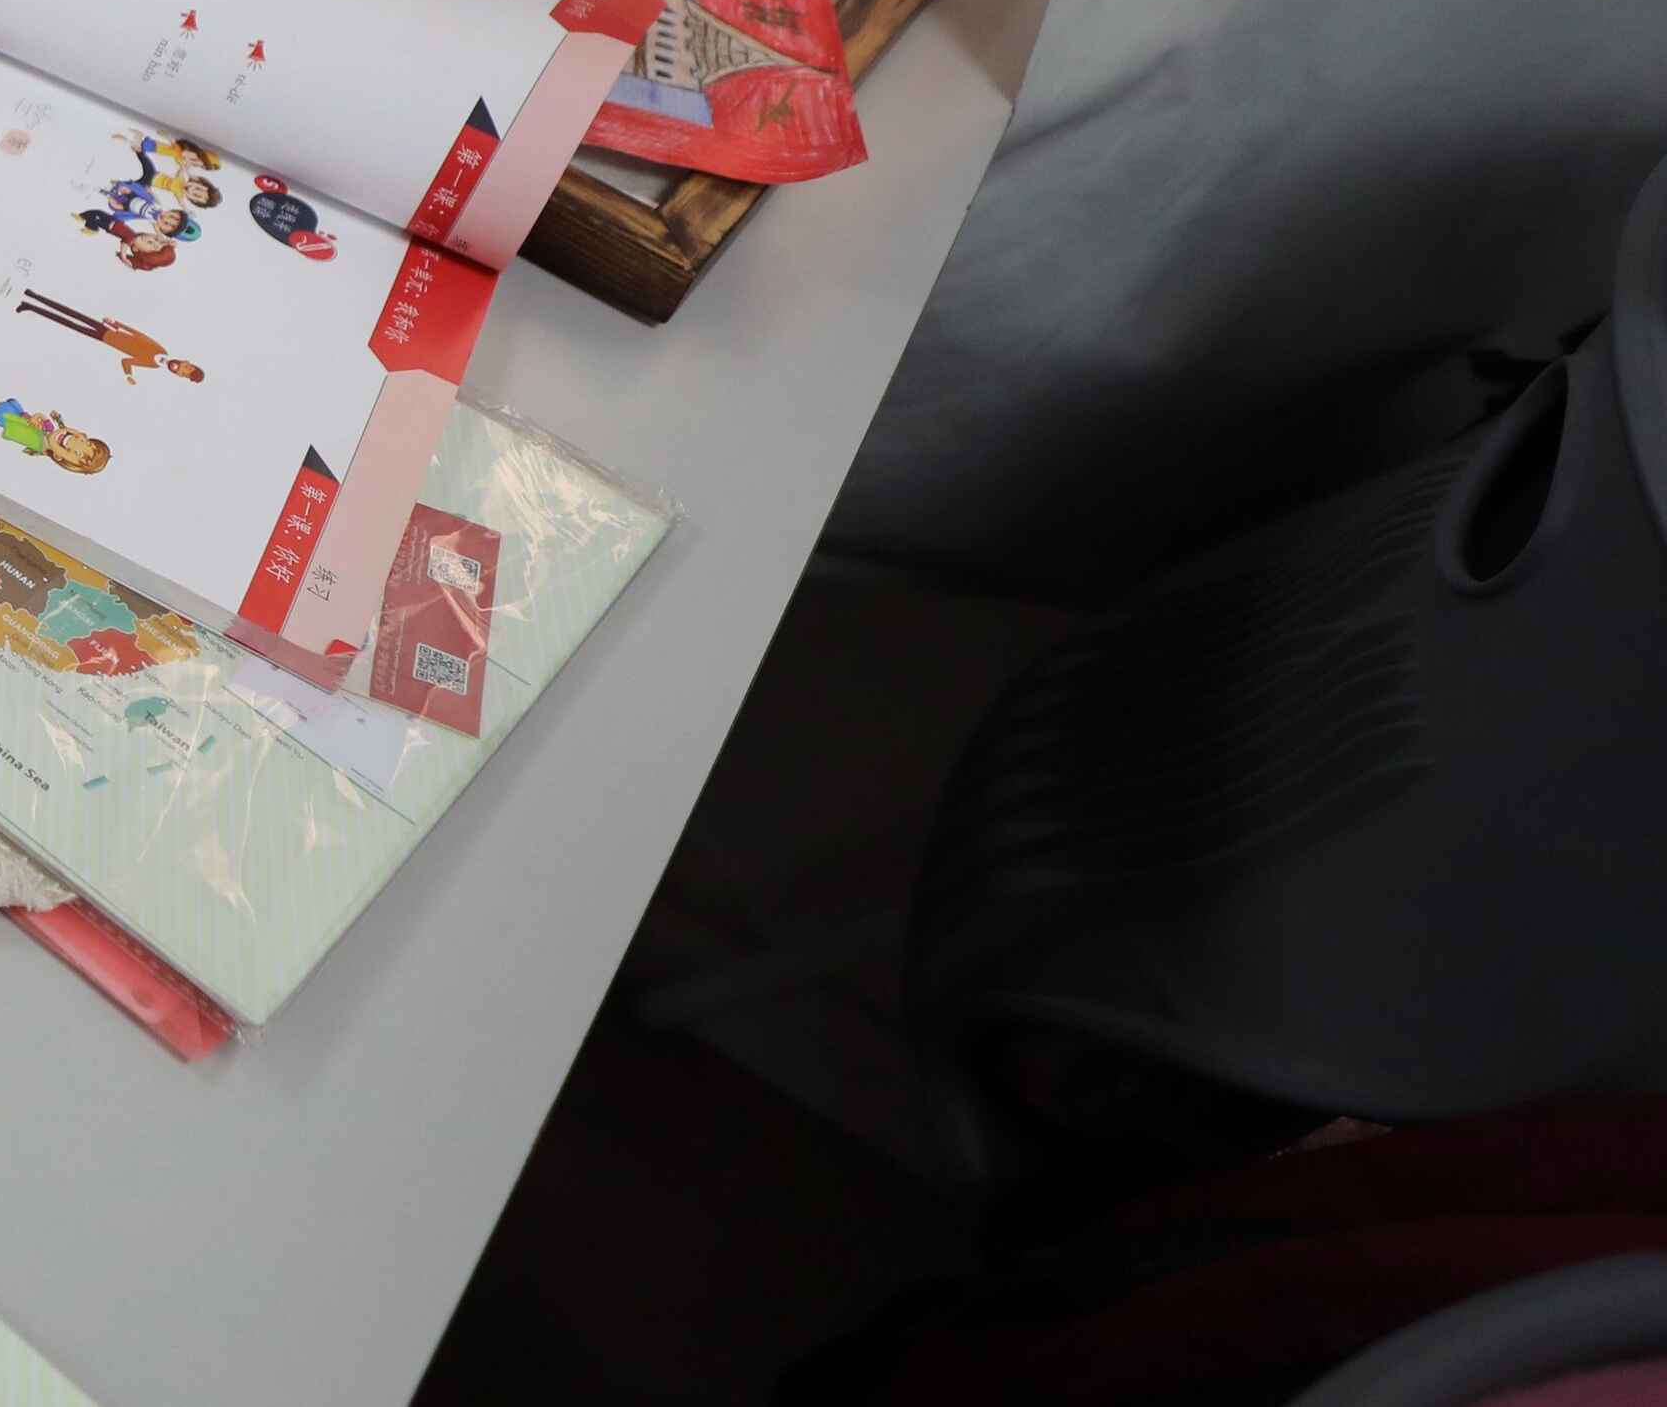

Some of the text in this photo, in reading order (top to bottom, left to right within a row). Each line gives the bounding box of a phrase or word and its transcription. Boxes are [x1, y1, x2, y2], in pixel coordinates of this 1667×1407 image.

[264, 480, 329, 585] 第一课：你好
[0, 560, 35, 589] HUNAN
[145, 712, 192, 751] Taiwan
[25, 768, 50, 791] Sea
